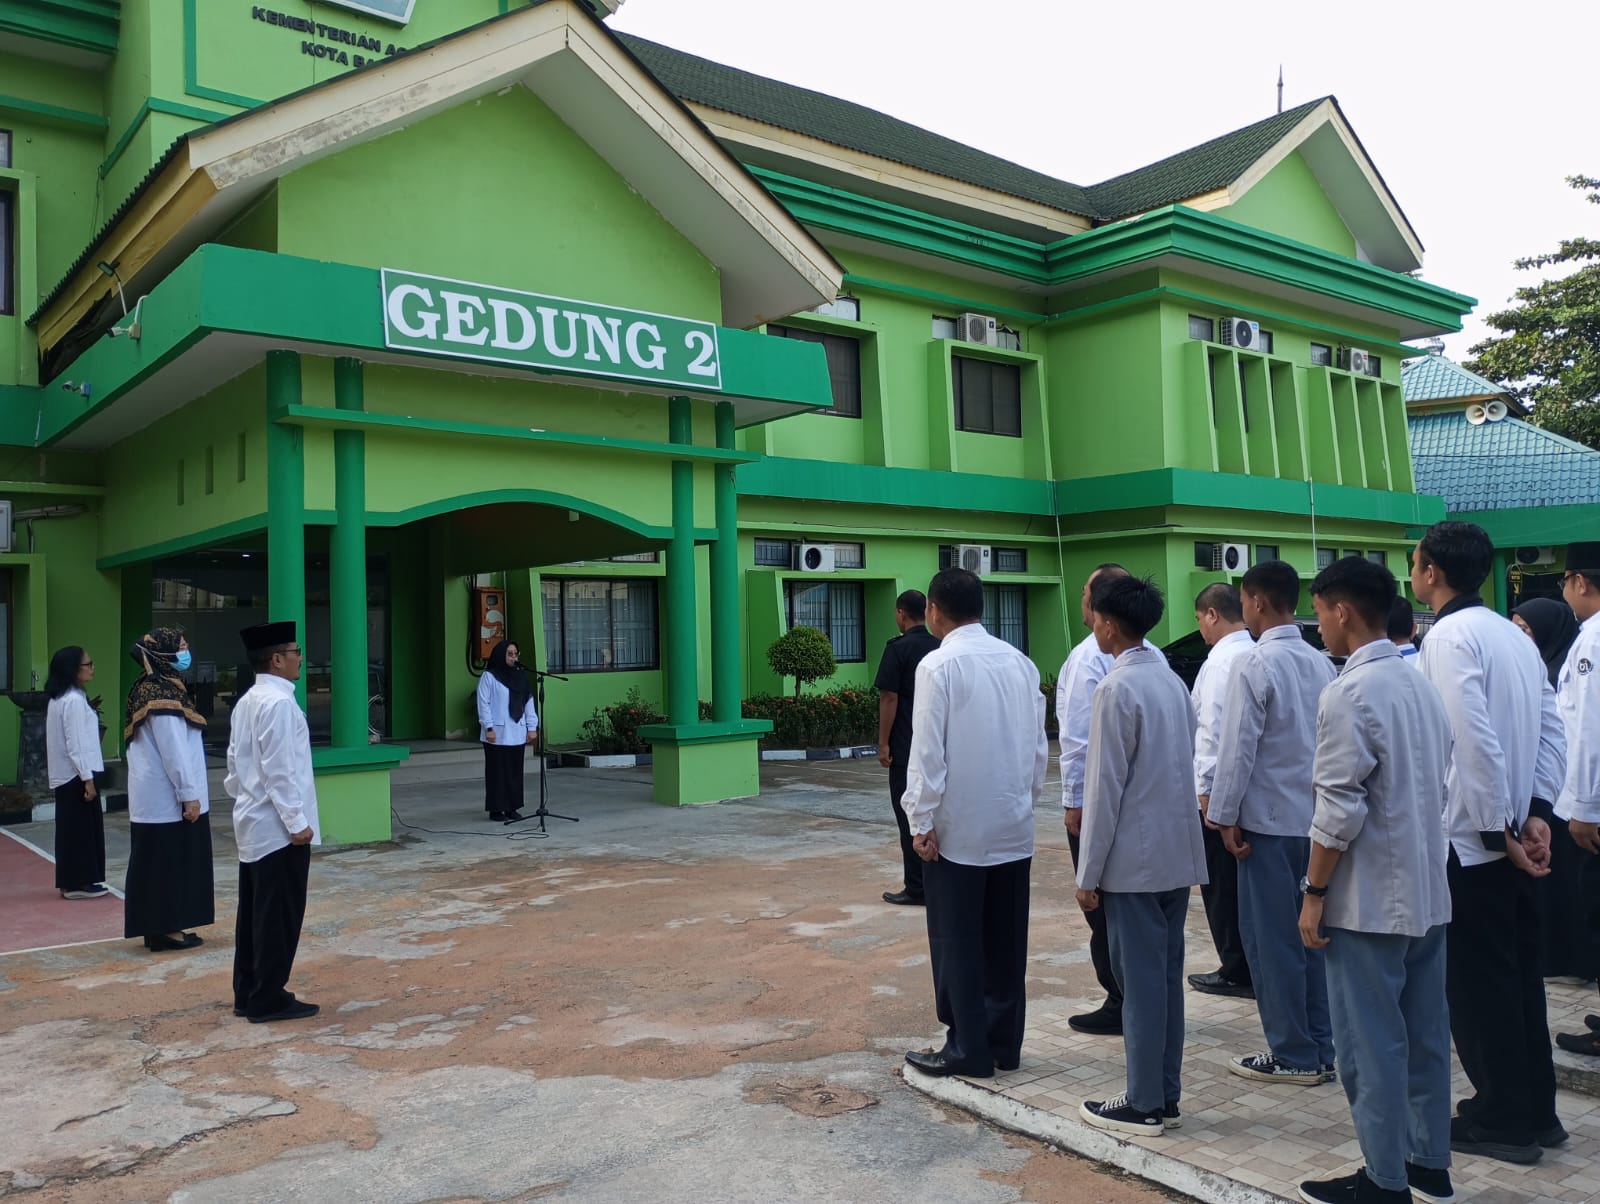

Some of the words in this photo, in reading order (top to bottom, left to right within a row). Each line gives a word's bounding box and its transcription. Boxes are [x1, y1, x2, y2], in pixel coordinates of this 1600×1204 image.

[252, 6, 381, 53] KEMENTERIAN
[301, 41, 349, 66] KOTA
[388, 284, 667, 371] GEDUNG
[684, 330, 717, 377] 2
